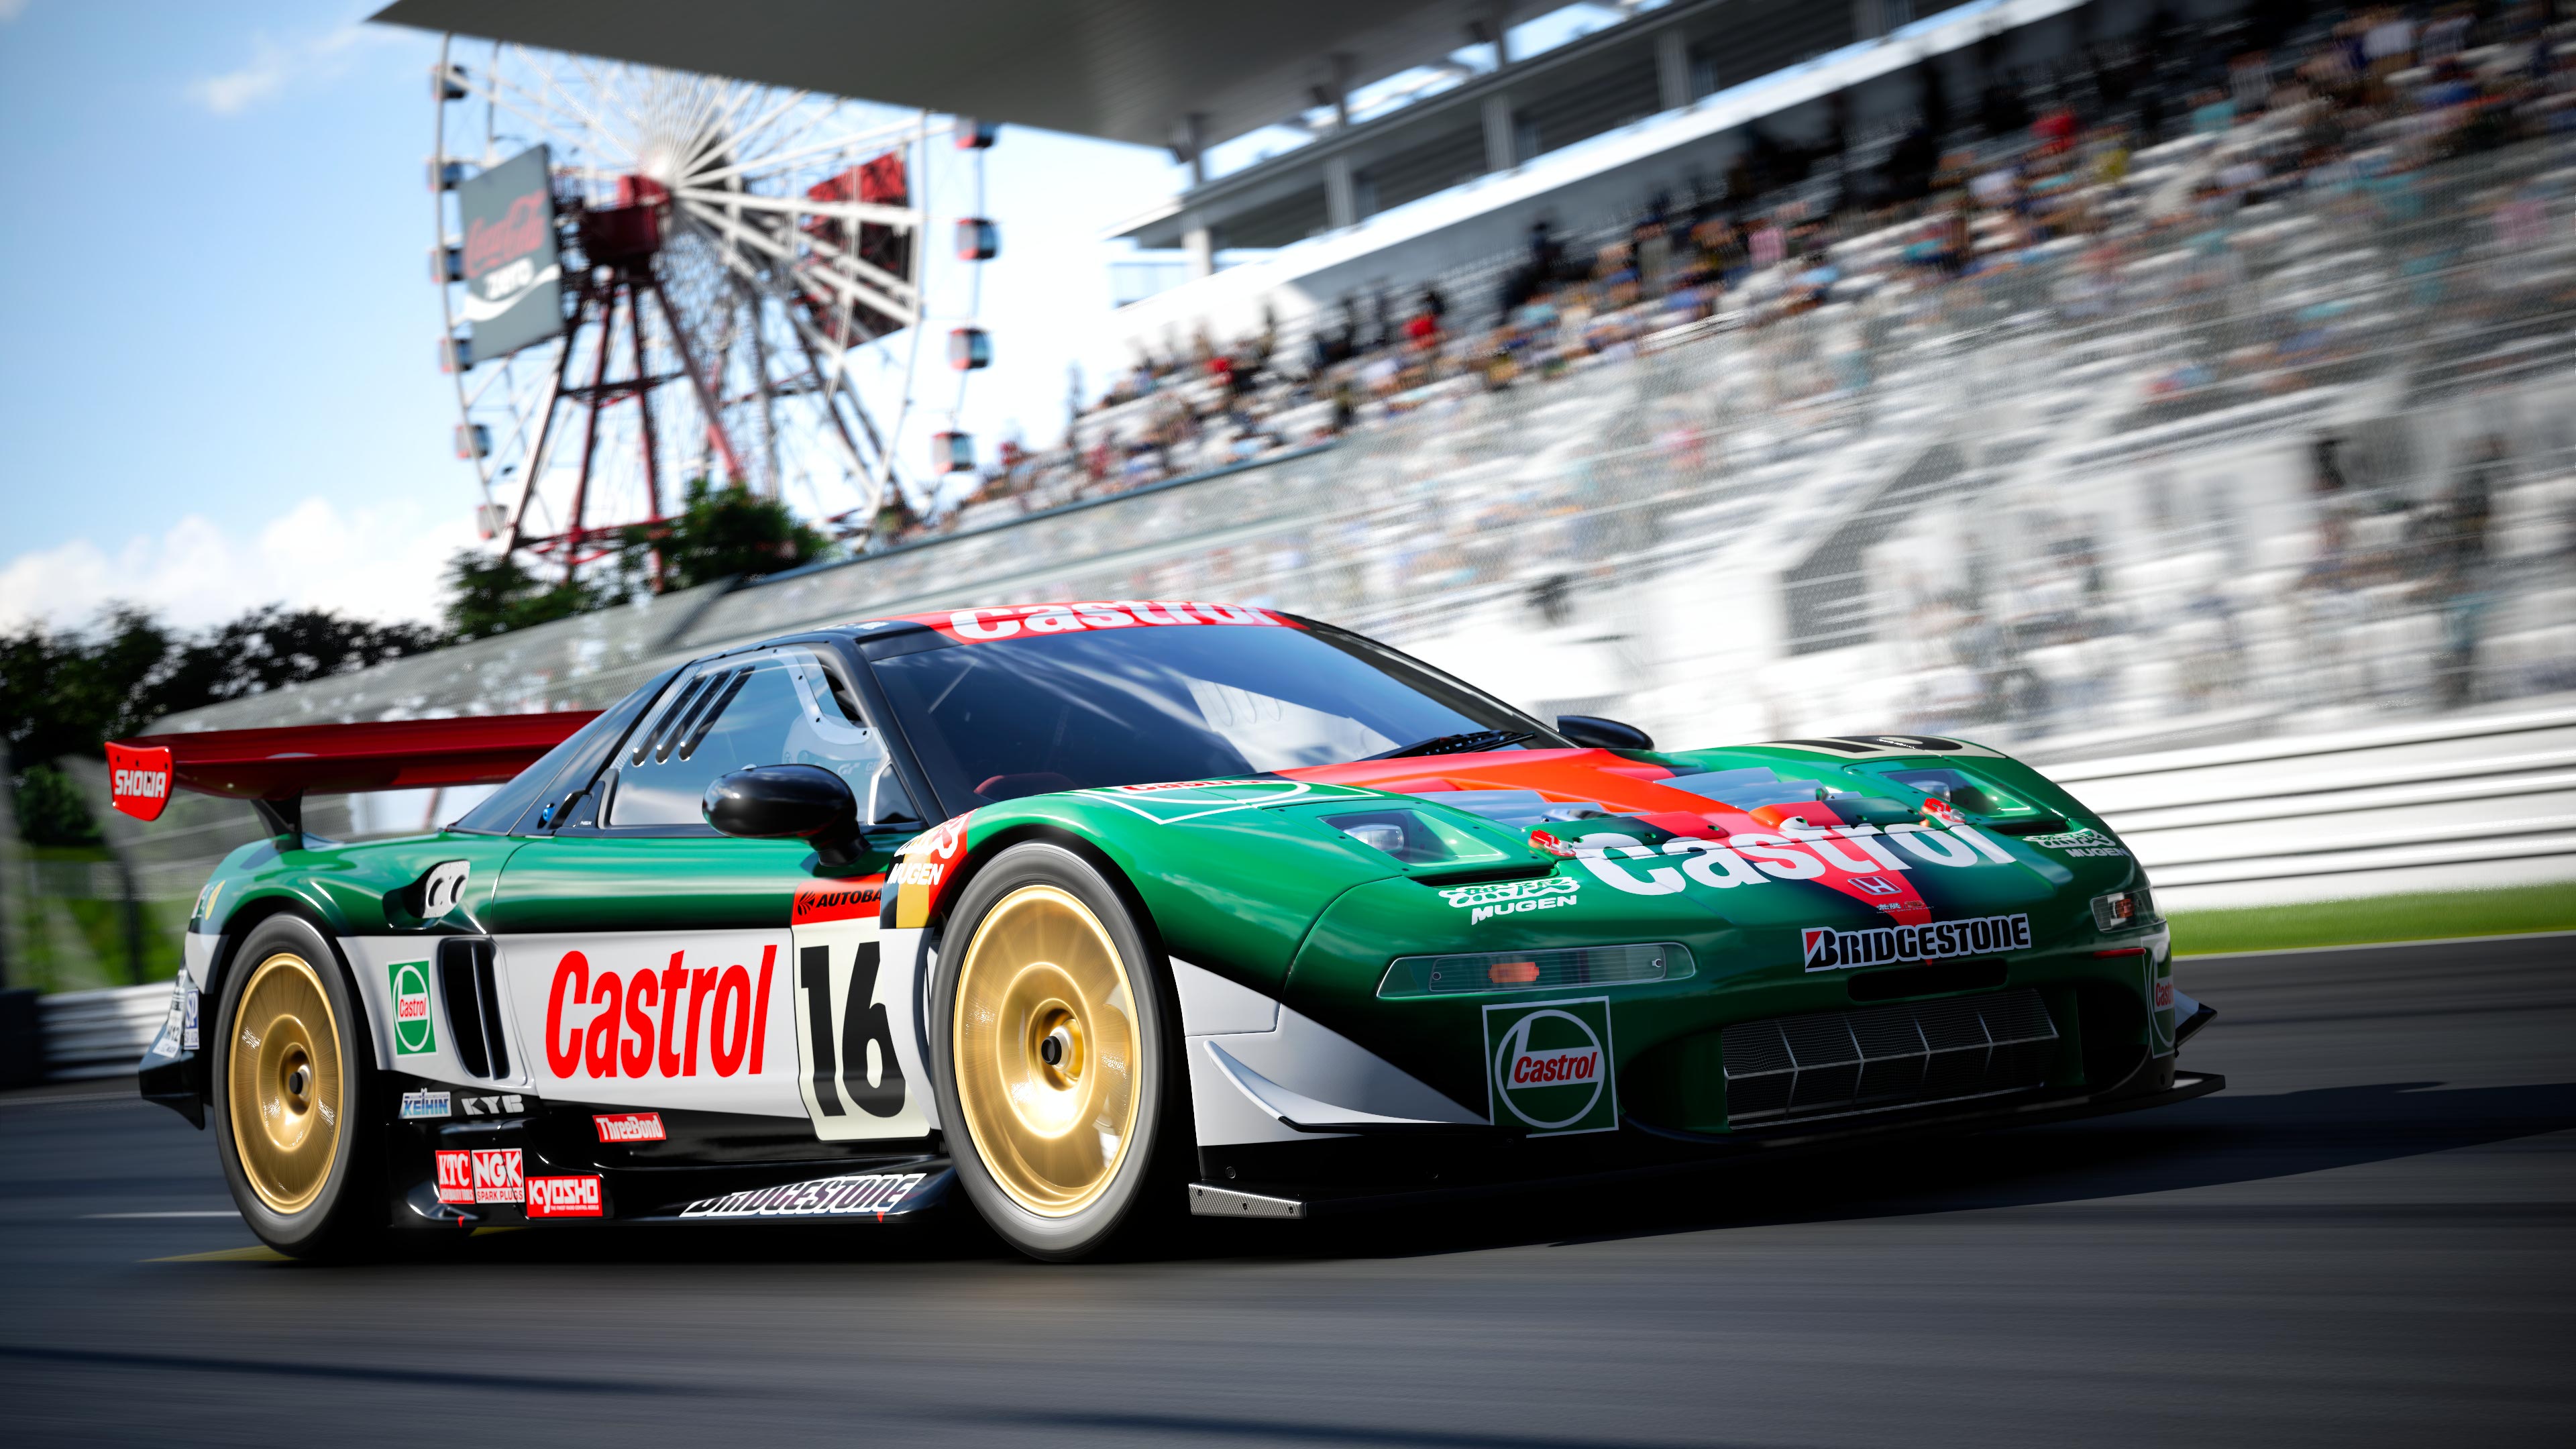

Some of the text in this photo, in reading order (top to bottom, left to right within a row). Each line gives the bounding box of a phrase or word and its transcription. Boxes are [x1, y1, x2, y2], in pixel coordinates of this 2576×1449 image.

[115, 769, 166, 798] SHOWA
[1574, 814, 2017, 896] Castrol
[2065, 847, 2130, 857] MUGEN
[887, 863, 945, 885] MUGEN
[1471, 895, 1576, 925] MUGEN
[1803, 914, 2030, 971] BRIDGESTONE
[399, 998, 427, 1018] Castrol
[545, 945, 777, 1079] Castrol
[800, 941, 906, 1118] 16
[1513, 1051, 1598, 1084] Castrol
[403, 1097, 449, 1116] KEIHIN
[461, 1094, 525, 1116] KYB
[595, 1115, 663, 1140] ThreeBond
[438, 1153, 470, 1187] KTC
[474, 1152, 523, 1188] NGK
[477, 1189, 523, 1201] SPARK PLUGS
[528, 1178, 599, 1214] KYOSHO
